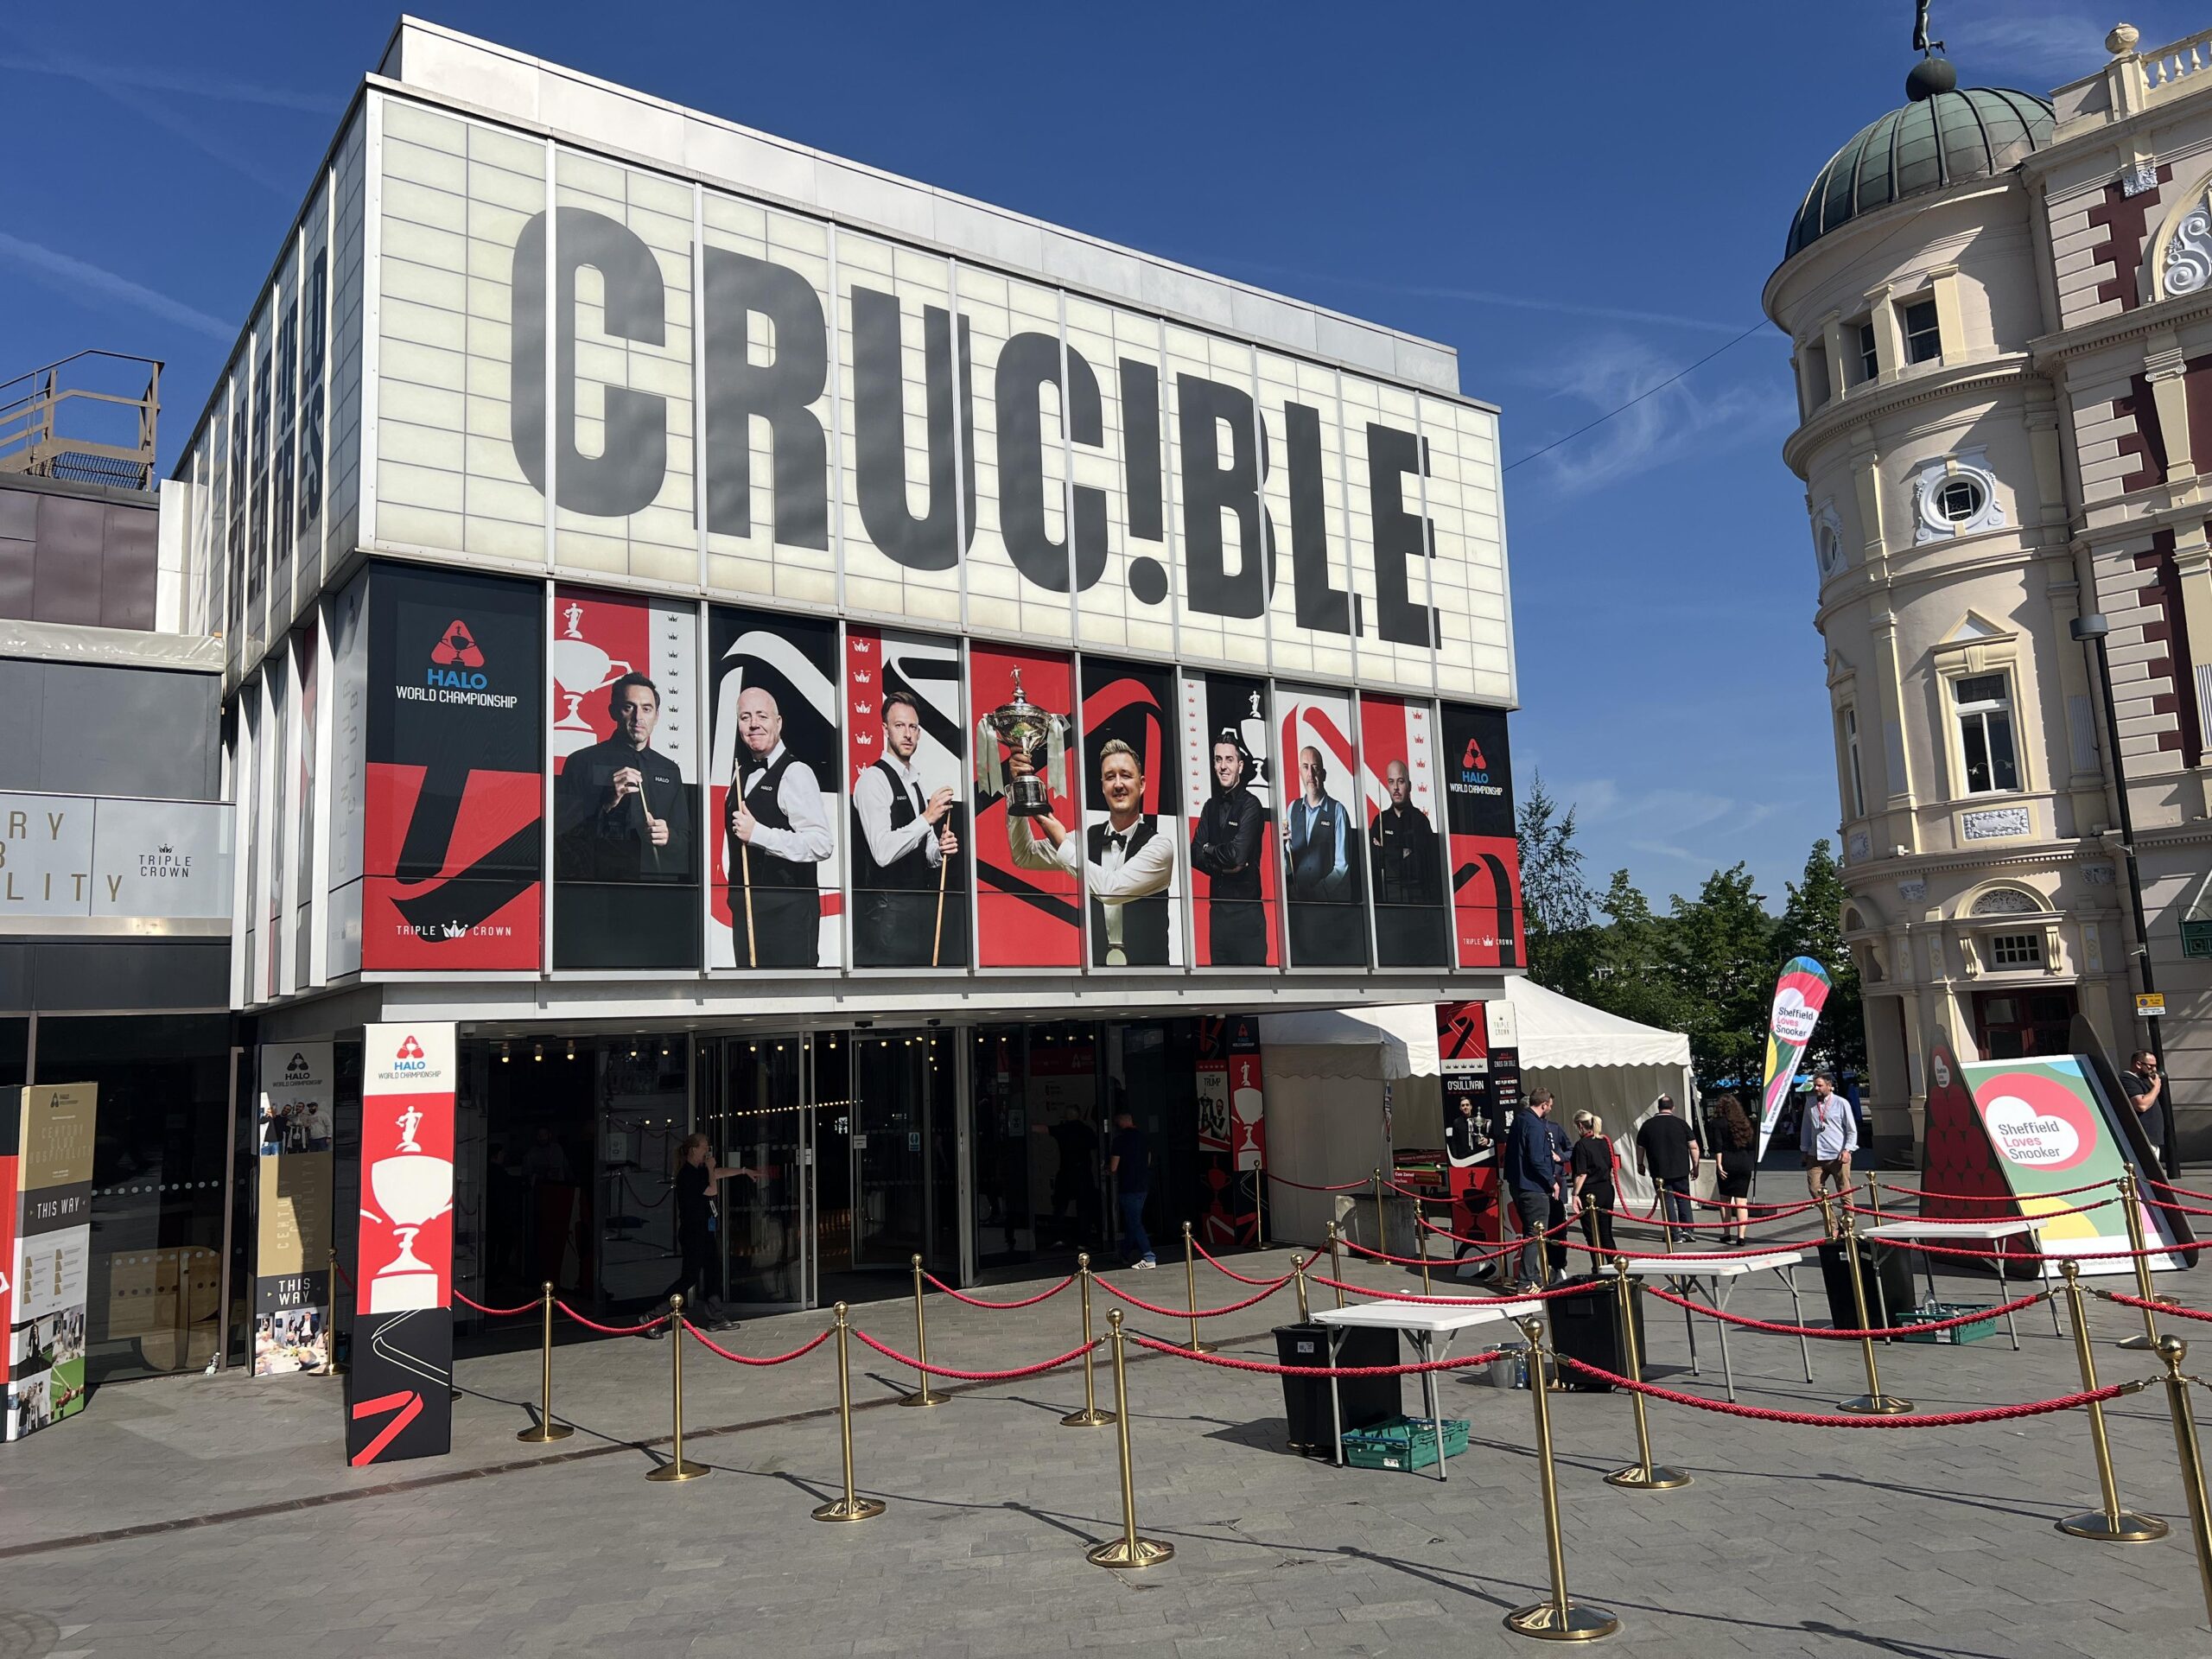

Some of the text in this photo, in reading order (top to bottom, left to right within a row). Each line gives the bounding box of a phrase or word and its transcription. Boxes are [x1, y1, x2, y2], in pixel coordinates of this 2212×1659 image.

[511, 207, 1441, 650] CRUC!BLE
[427, 668, 488, 690] HALO
[396, 685, 518, 709] WORLD CHAMPIONSHIP
[1461, 771, 1489, 784] HALO
[1449, 782, 1503, 796] WORLD CHAMPIONSHIP
[139, 855, 192, 867] TRIPLE
[141, 866, 189, 878] CROWN
[396, 925, 512, 936] TRIPLE CROWN
[1778, 1007, 1814, 1020] Sheffield
[1777, 1016, 1799, 1027] Loves
[1776, 1024, 1808, 1037] Snooker
[394, 1060, 426, 1071] HALO
[400, 1071, 442, 1079] CHAMPIONSHIP
[1204, 1077, 1221, 1087] TRUMP
[1447, 1080, 1484, 1090] O'SULLIVAN
[1998, 1121, 2060, 1135] Sheffield
[2003, 1136, 2042, 1147] Loves
[2009, 1147, 2060, 1160] Snooker
[36, 1197, 79, 1219] THIS WAY
[278, 1278, 311, 1293] THIS
[278, 1291, 310, 1306] WAY
